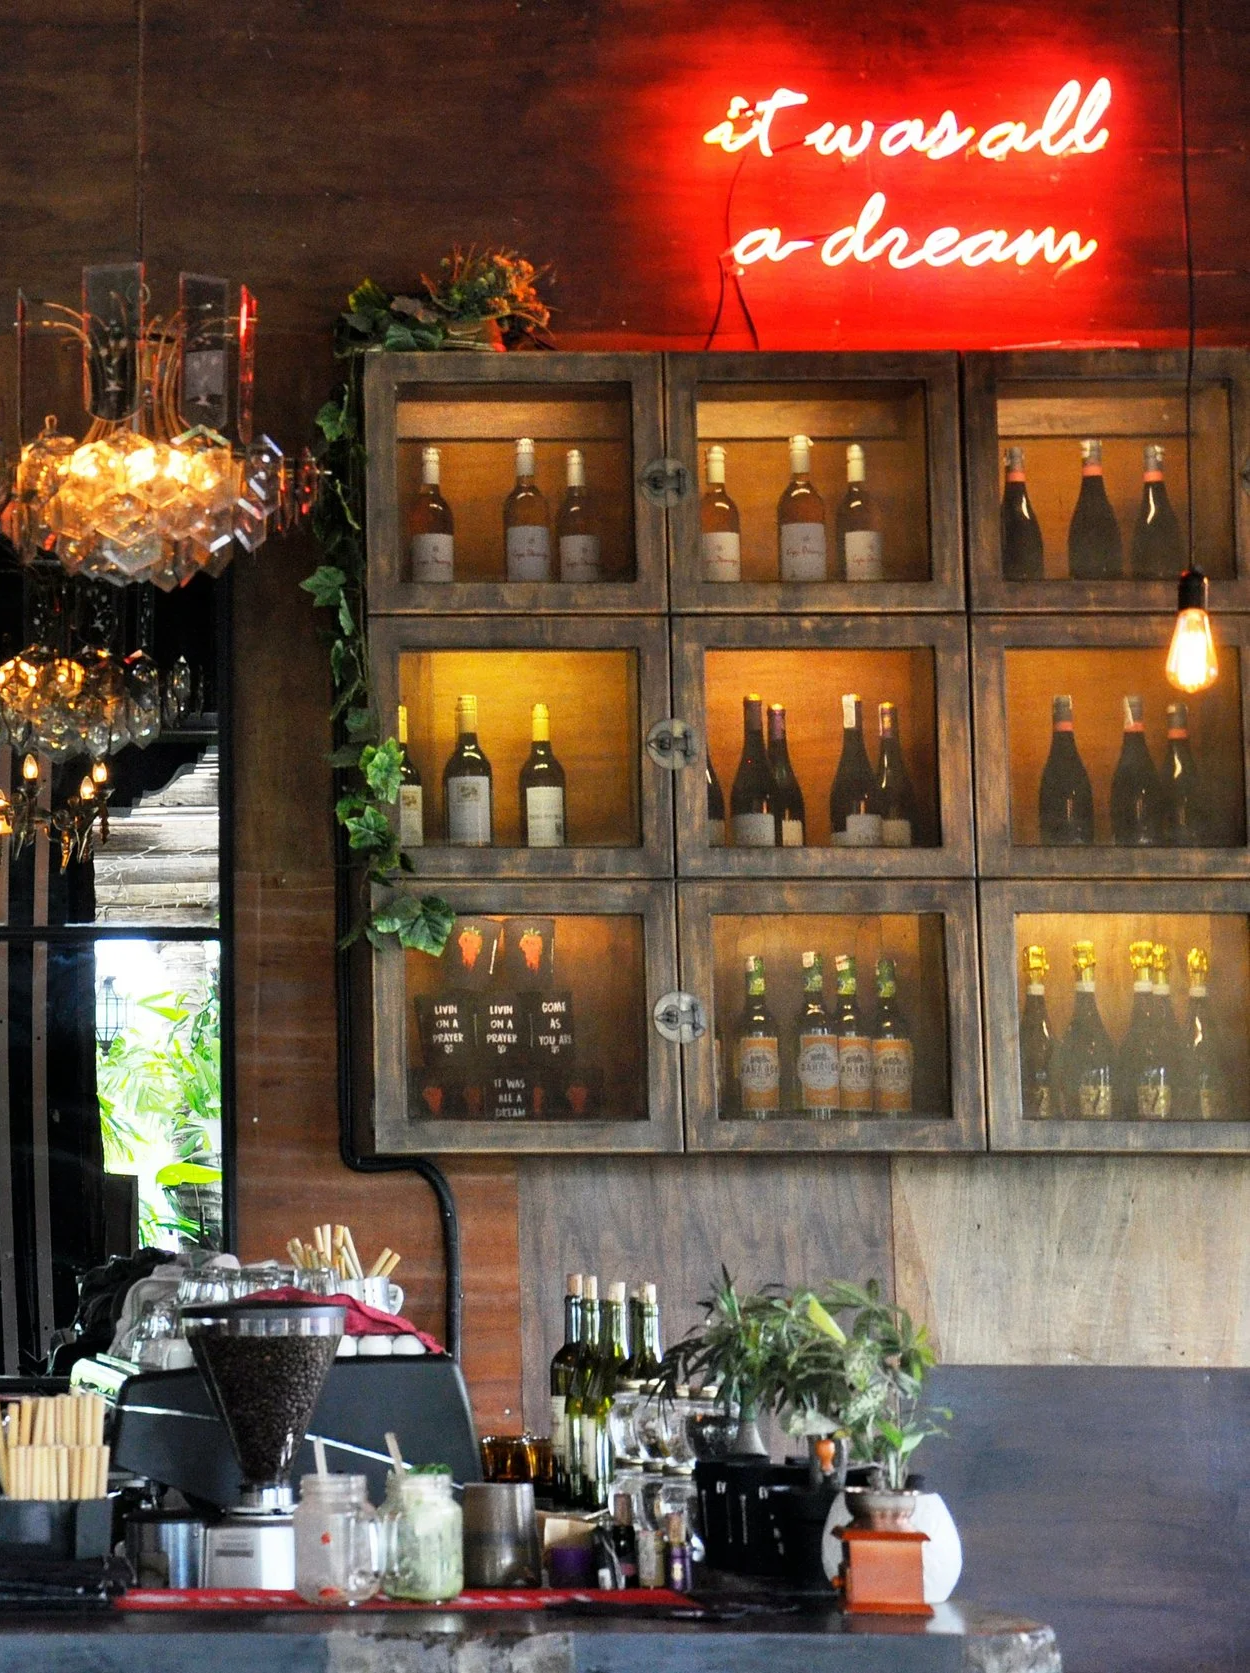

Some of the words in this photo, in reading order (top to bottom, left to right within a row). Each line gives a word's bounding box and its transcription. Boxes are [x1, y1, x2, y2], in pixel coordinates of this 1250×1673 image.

[703, 87, 808, 157] it
[804, 109, 975, 160] was
[978, 76, 1112, 156] all
[732, 227, 813, 264] a
[821, 191, 1098, 269] dream
[434, 1004, 458, 1015] LIVIN
[489, 1005, 513, 1016] LIVIN
[435, 1019, 449, 1029] ON
[452, 1019, 459, 1029] A
[490, 1019, 504, 1029] ON
[506, 1018, 513, 1029] A
[550, 1018, 562, 1029] AS
[433, 1033, 464, 1043] PRAYER
[486, 1033, 518, 1044] PRAYER
[538, 1035, 556, 1046] YOU
[494, 1079, 502, 1088] IT
[506, 1079, 526, 1089] WAS
[516, 1093, 522, 1103] A
[495, 1107, 526, 1118] DREAM
